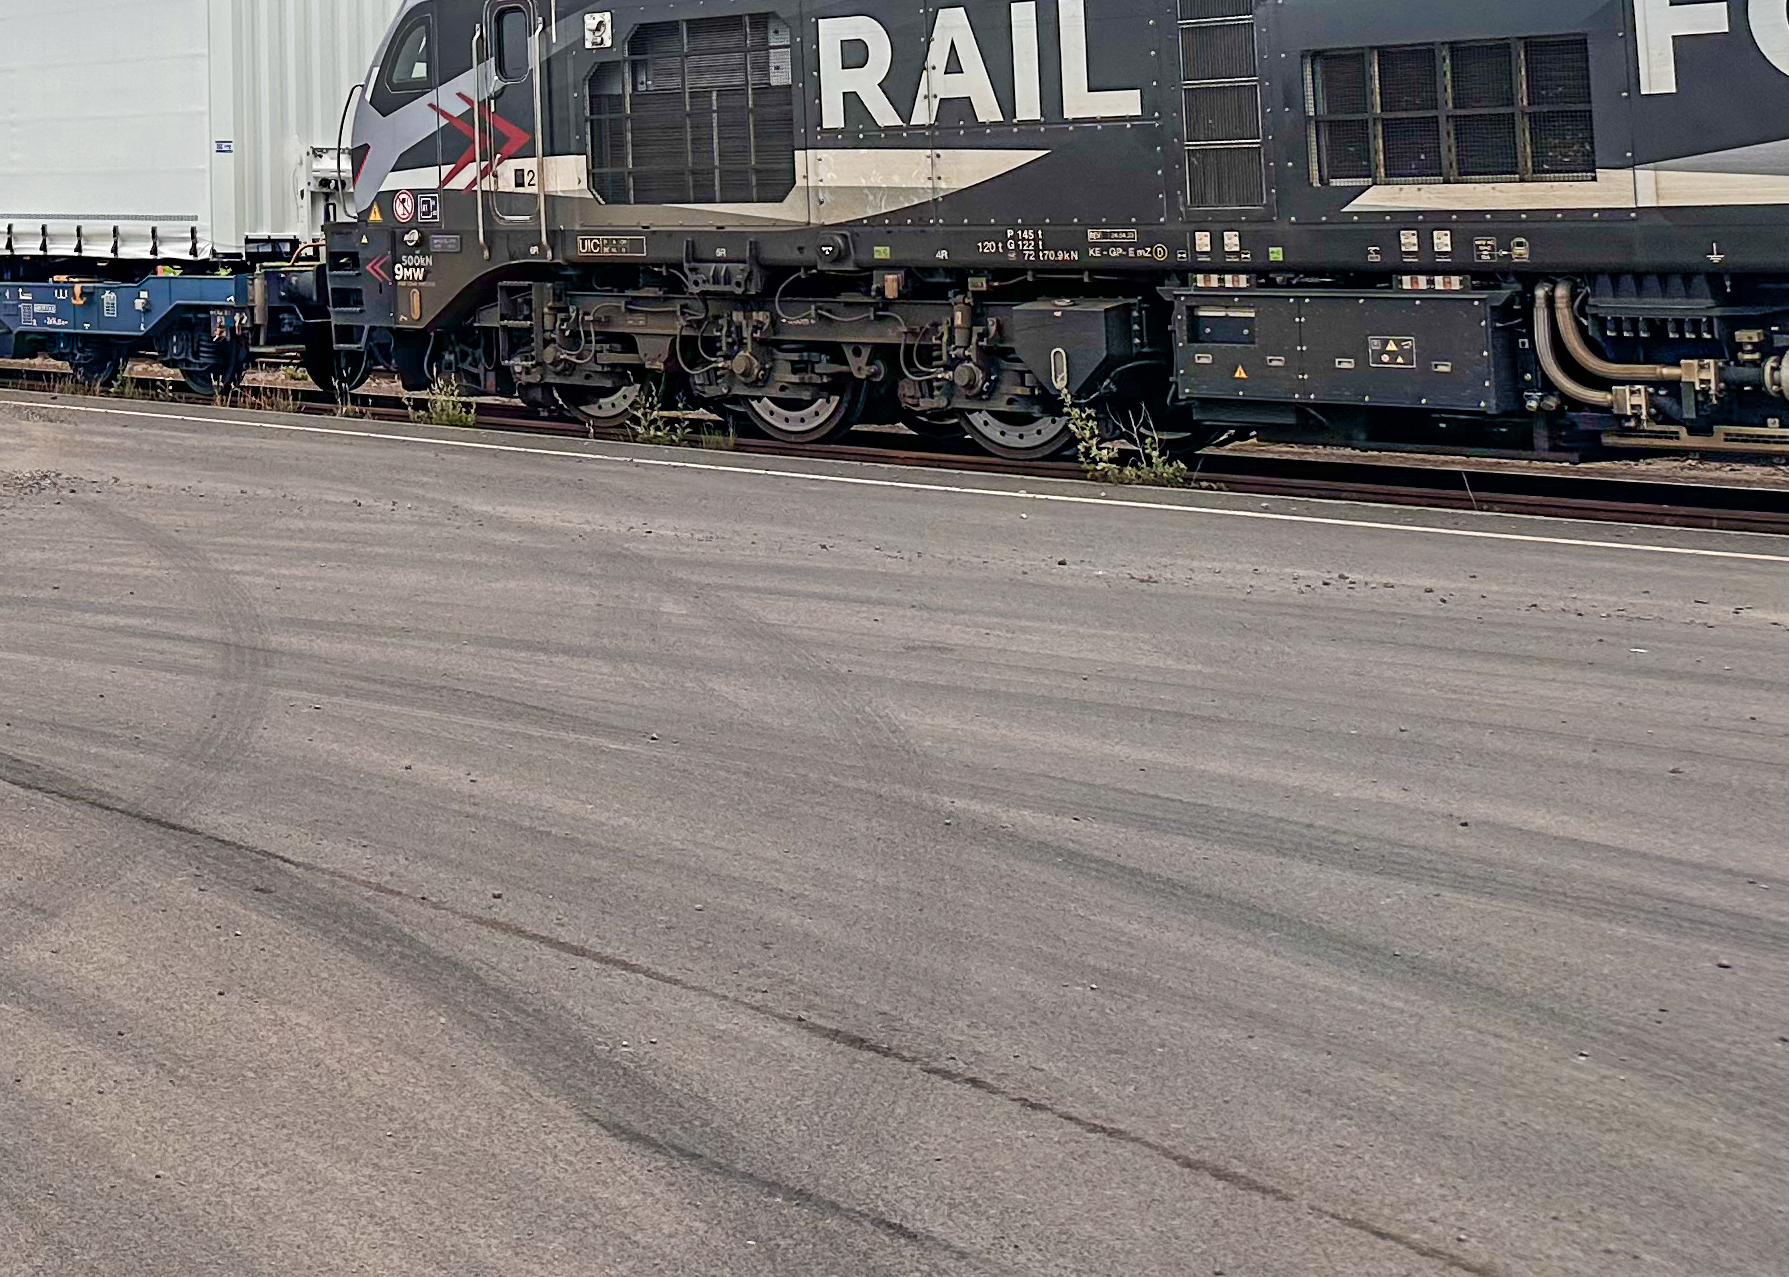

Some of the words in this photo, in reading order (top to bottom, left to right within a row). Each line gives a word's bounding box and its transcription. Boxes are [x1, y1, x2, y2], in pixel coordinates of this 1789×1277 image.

[527, 170, 536, 187] 2
[1007, 229, 1015, 239] P
[1017, 230, 1034, 239] 145
[579, 239, 600, 253] UIC
[977, 242, 996, 253] 120
[1007, 240, 1015, 250] G
[1018, 241, 1034, 250] 122
[402, 255, 433, 266] 500kN
[1023, 250, 1035, 261] 72
